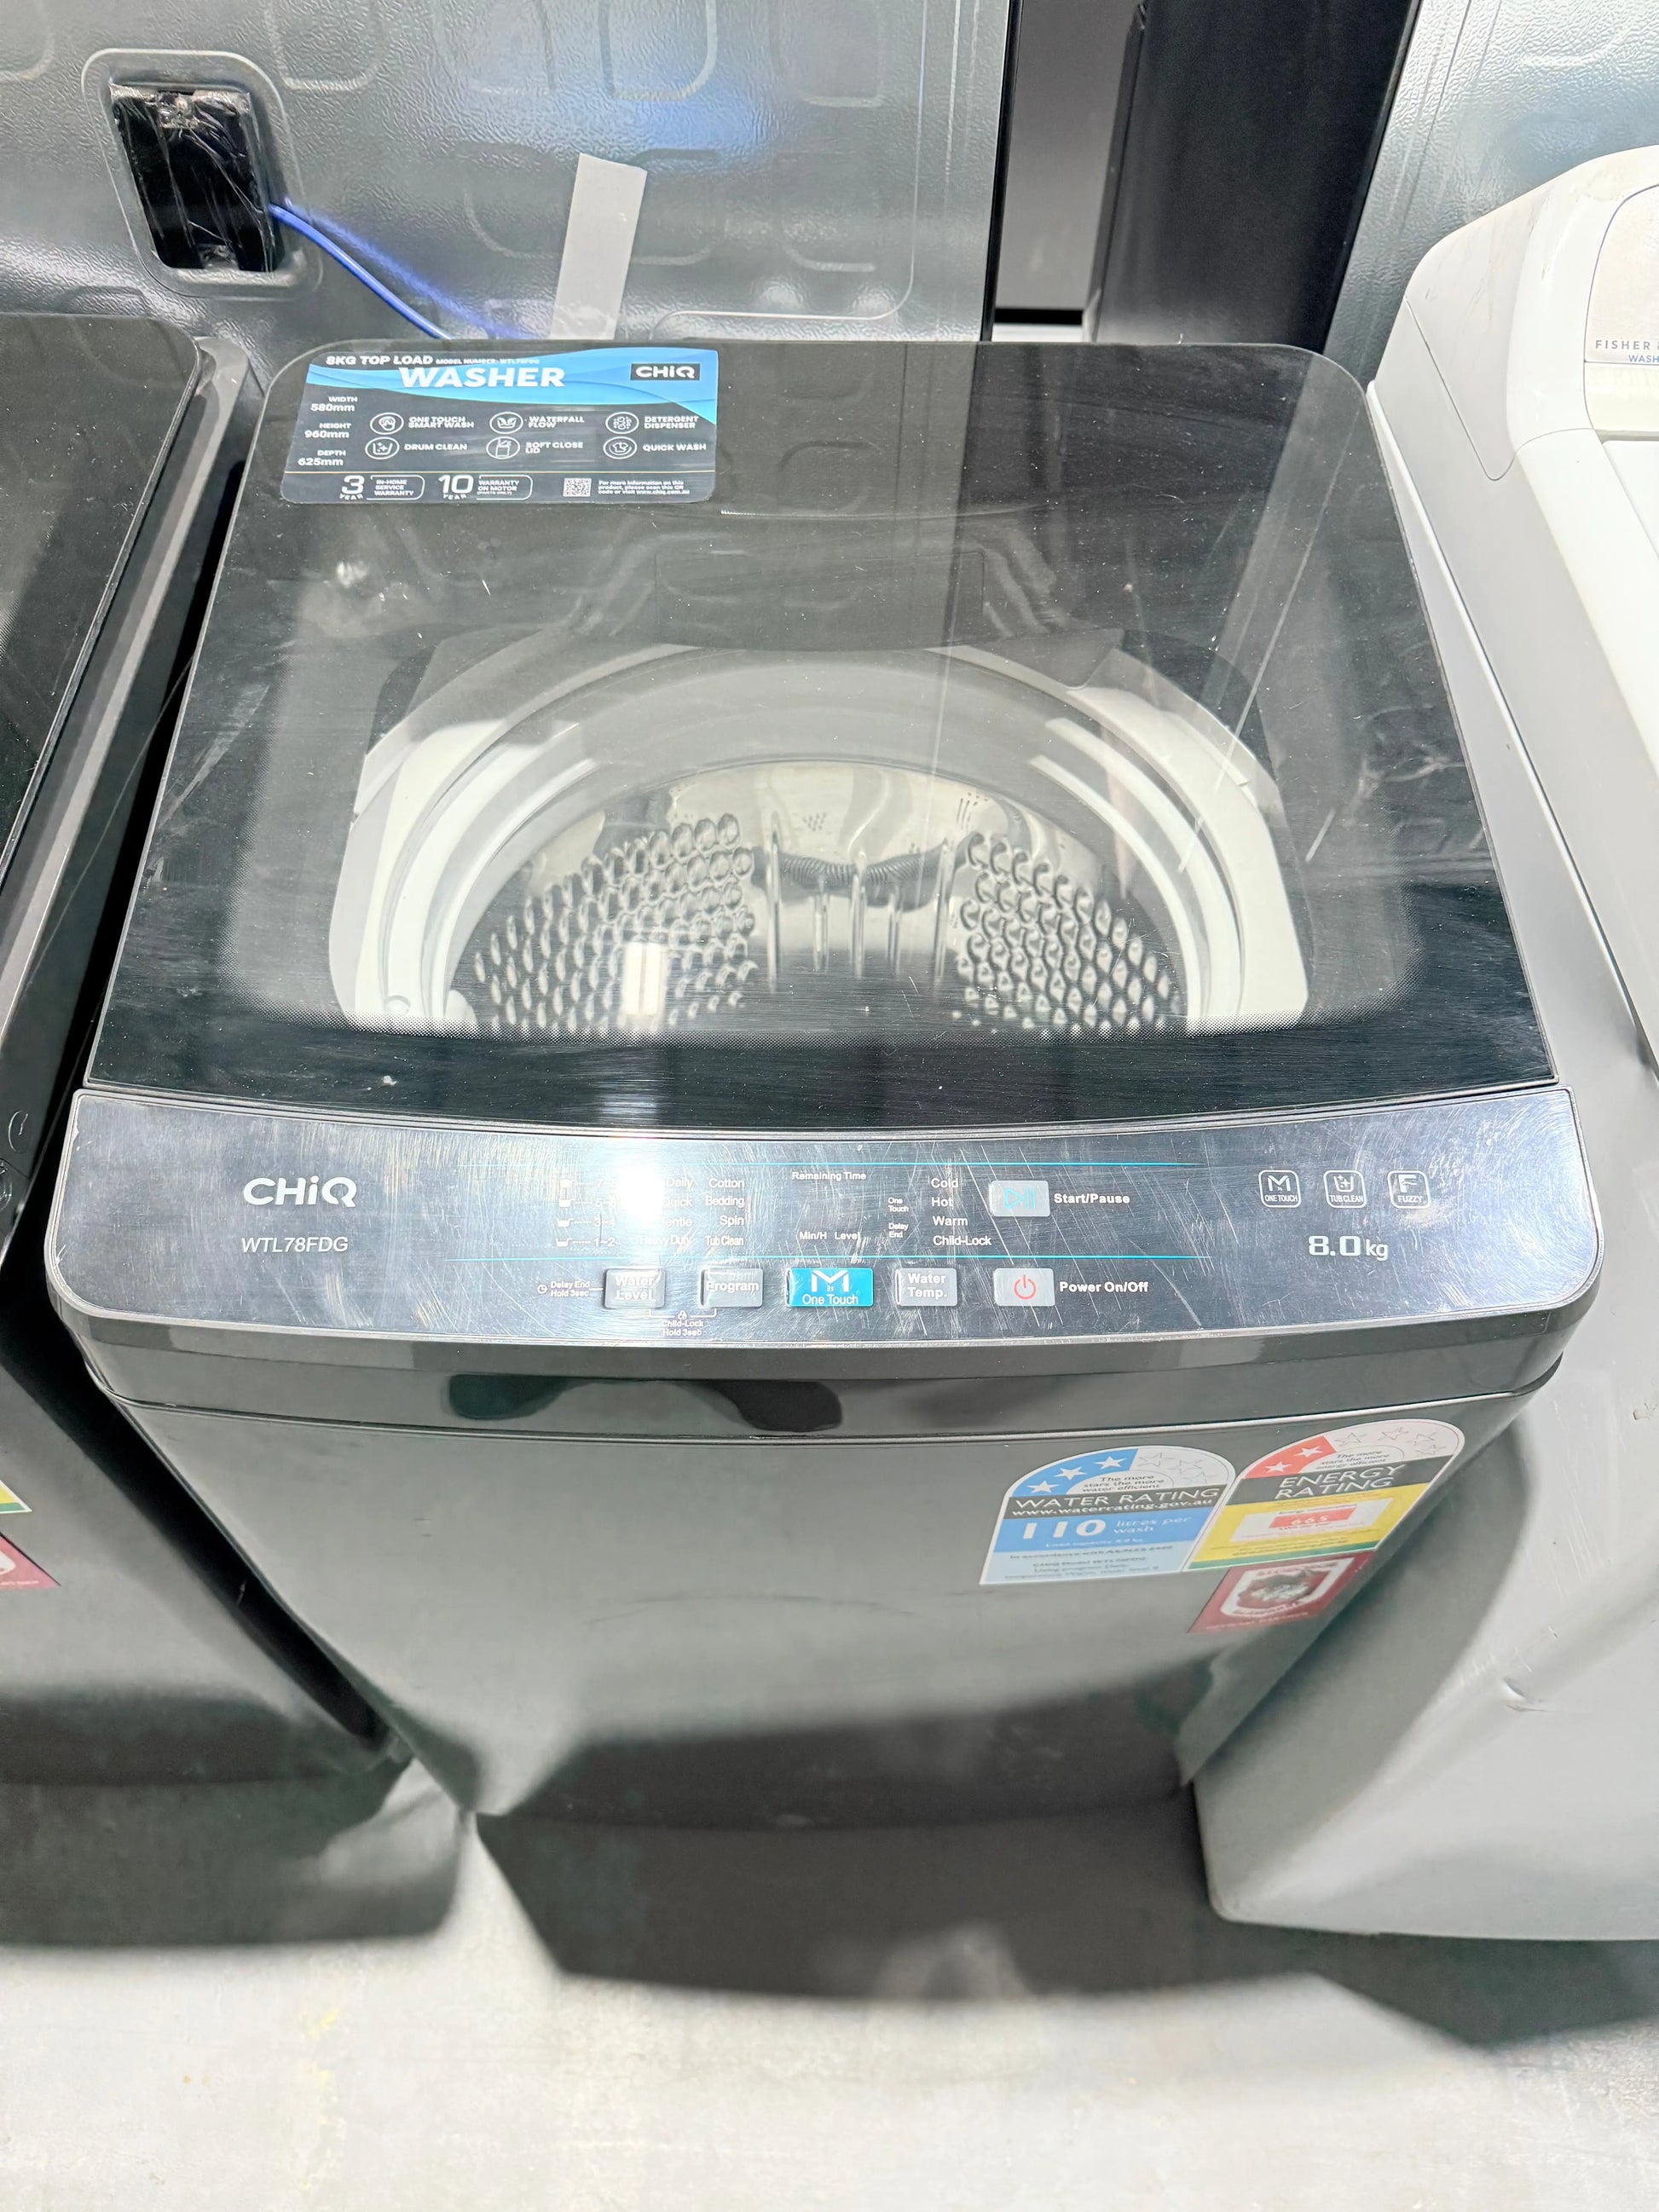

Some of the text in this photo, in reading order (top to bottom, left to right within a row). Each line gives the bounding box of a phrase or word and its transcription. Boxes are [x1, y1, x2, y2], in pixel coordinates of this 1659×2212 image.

[1595, 340, 1651, 350] FISHER
[326, 355, 356, 365] 8KG
[360, 355, 390, 365] TOP
[393, 355, 434, 365] LOAD
[398, 367, 566, 388] WASHER
[635, 366, 696, 378] CHiQ
[310, 403, 356, 412] 580mm
[298, 458, 344, 466] 625mm
[341, 475, 365, 494] 3
[438, 474, 474, 494] 10
[791, 1171, 867, 1181] Remaining Time
[667, 1178, 694, 1190] Daily
[708, 1178, 745, 1188] Cotton
[930, 1177, 959, 1188] Cold
[242, 1175, 358, 1208] CHiQ
[704, 1195, 745, 1209] Bedding
[931, 1197, 953, 1208] Hot
[1054, 1193, 1130, 1204] Start/Pause
[1277, 1194, 1298, 1203] TOUCH
[719, 1215, 745, 1228] Spin
[888, 1222, 909, 1231] Delay
[933, 1216, 968, 1227] Warm
[705, 1236, 744, 1246] Tub Clean
[799, 1231, 860, 1241] Min/H Level
[933, 1235, 992, 1246] Child-Lock
[241, 1236, 349, 1253] WTL78FDG
[1308, 1235, 1389, 1262] 8.0 kg
[551, 1280, 590, 1290] Delay End
[615, 1275, 655, 1287] Water
[811, 1269, 850, 1293] M
[907, 1273, 947, 1285] Water
[705, 1280, 760, 1293] Program
[1059, 1280, 1149, 1293] Power On/Off
[551, 1289, 589, 1297] Hold 3sec
[615, 1289, 654, 1302] Level
[907, 1287, 948, 1299] Temp.
[801, 1294, 859, 1305] One Touch
[662, 1328, 702, 1337] Hold 3sec
[1279, 1464, 1407, 1488] ENERGY
[1275, 1477, 1395, 1499] RATING
[1014, 1487, 1221, 1509] WATER RATING
[1012, 1498, 1213, 1516] www.waterrating.gov.au
[1022, 1516, 1194, 1539] 110 litres per
[1113, 1526, 1154, 1534] wash
